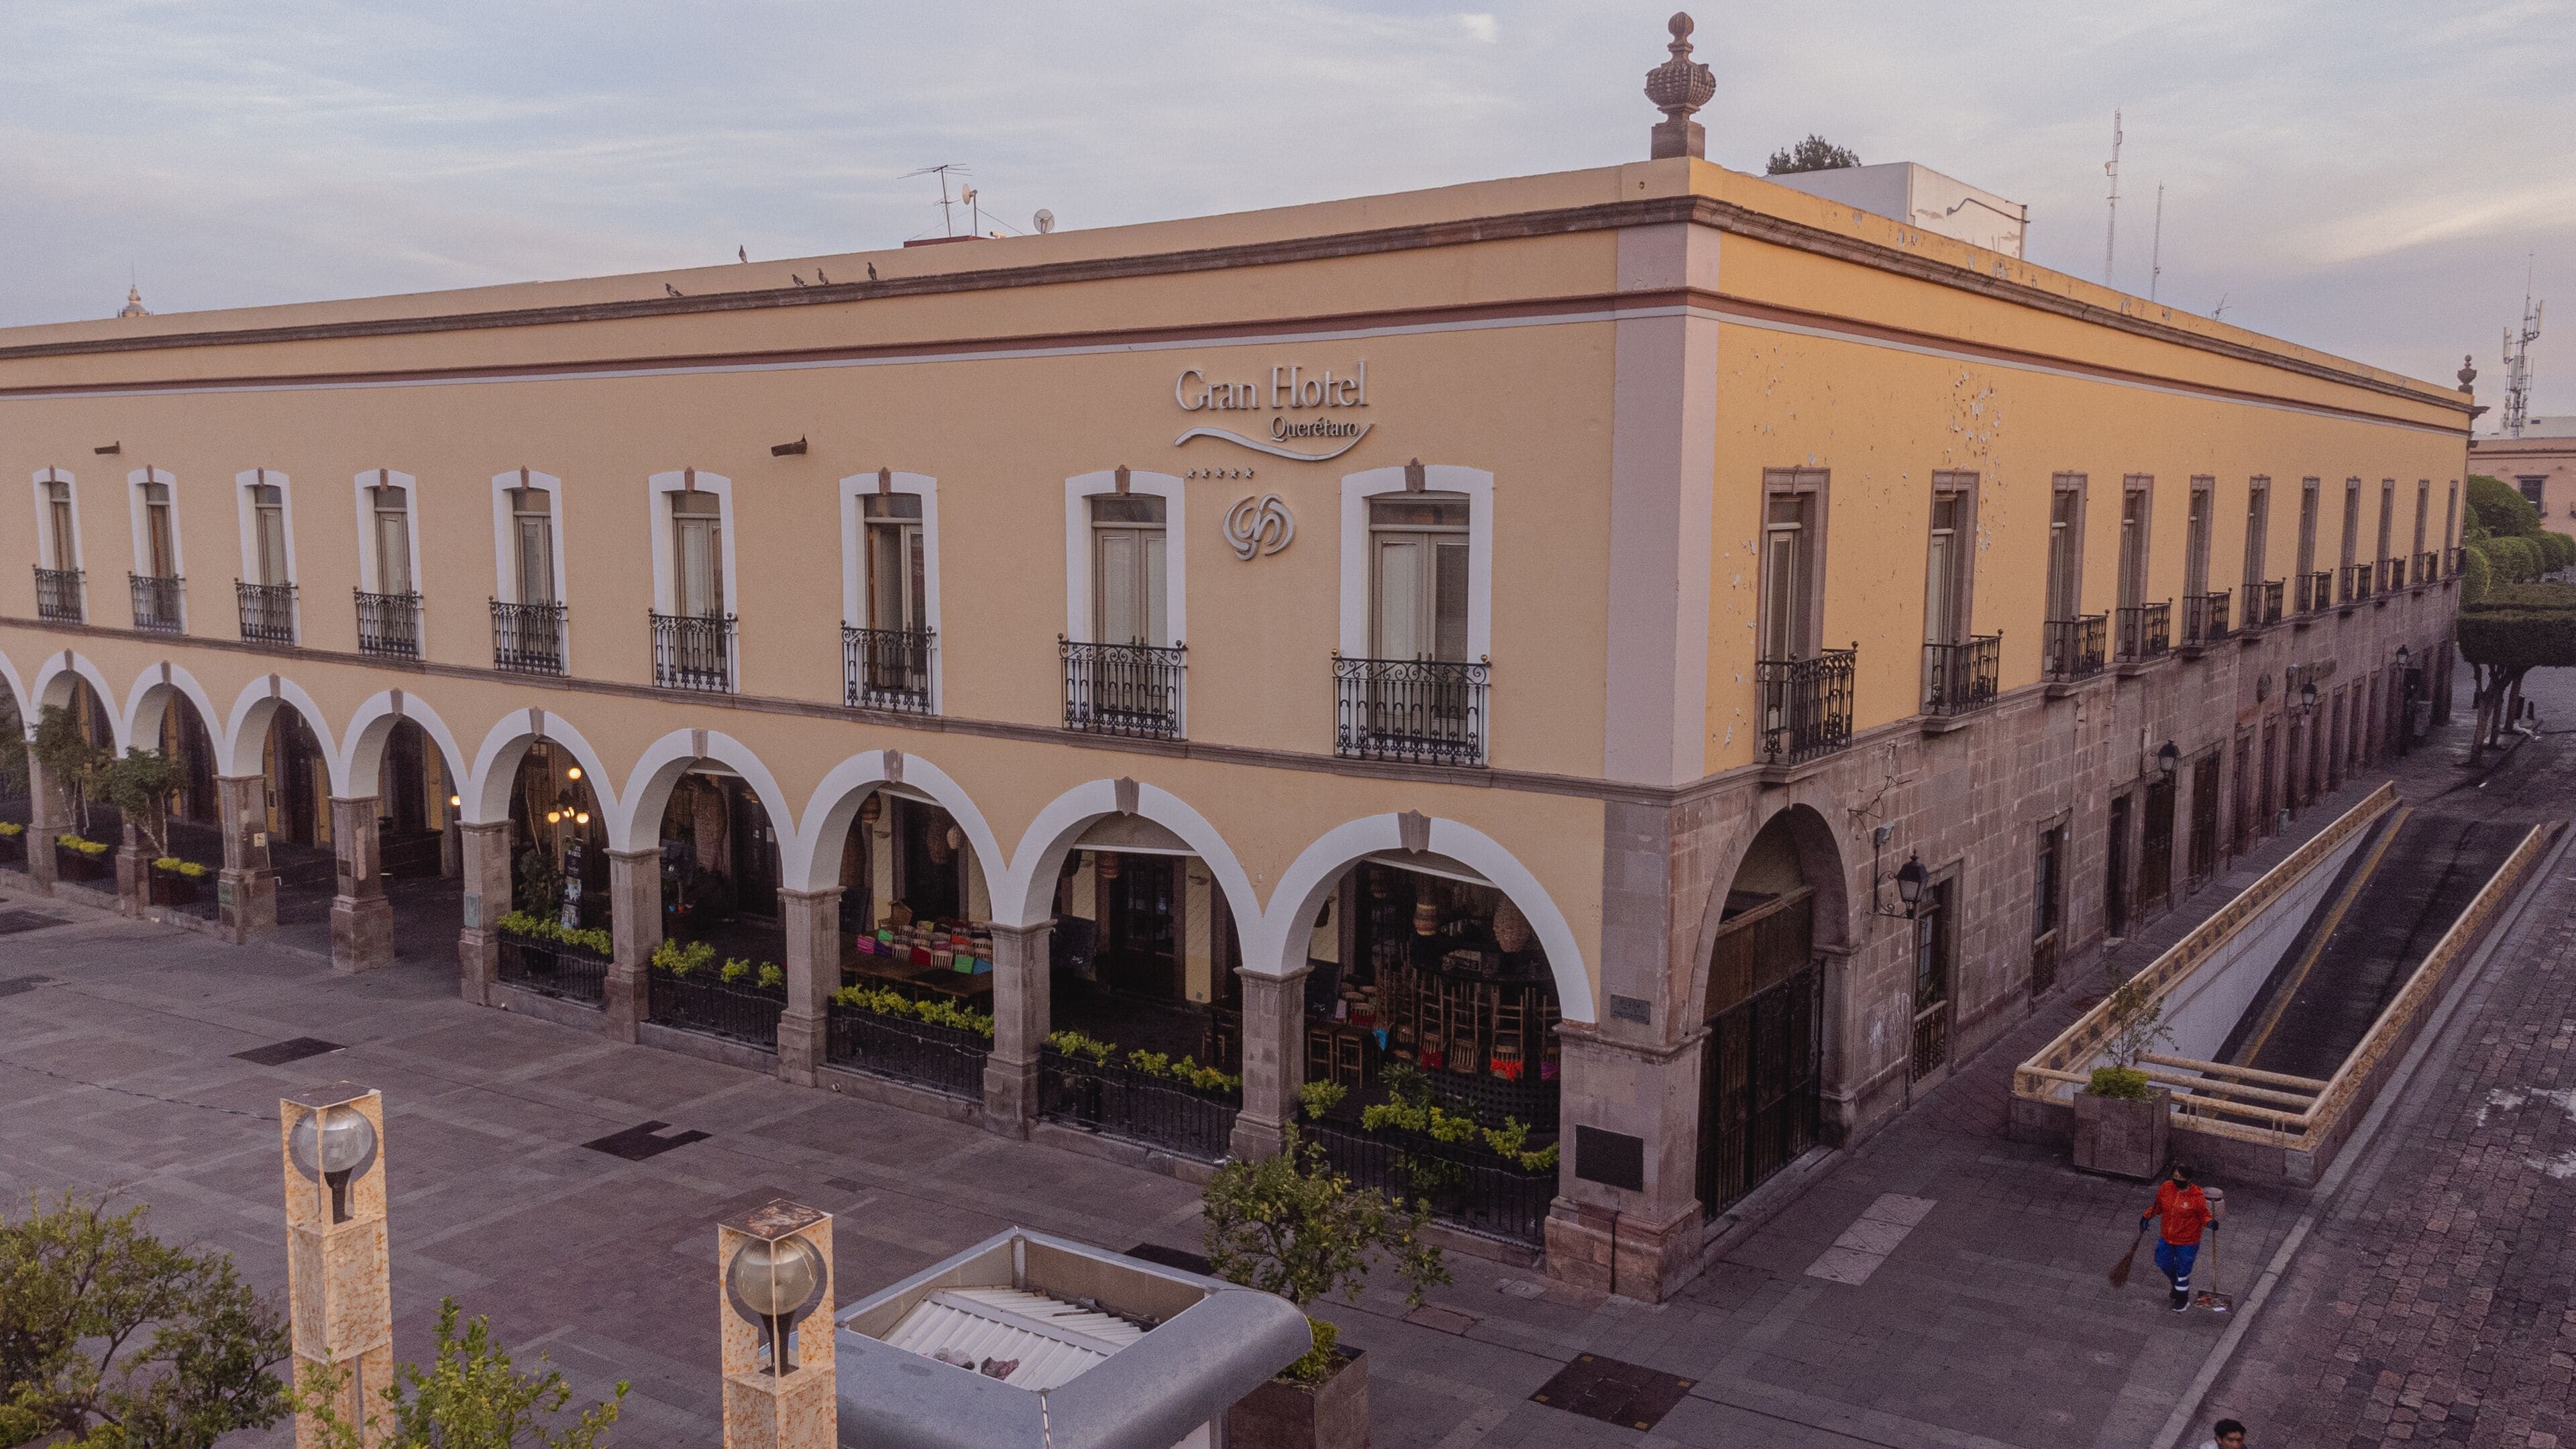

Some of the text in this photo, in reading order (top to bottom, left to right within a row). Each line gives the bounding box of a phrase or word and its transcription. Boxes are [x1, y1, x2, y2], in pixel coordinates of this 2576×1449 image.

[1175, 360, 1369, 411] Gran Hotel
[1270, 416, 1360, 443] Querétaro
